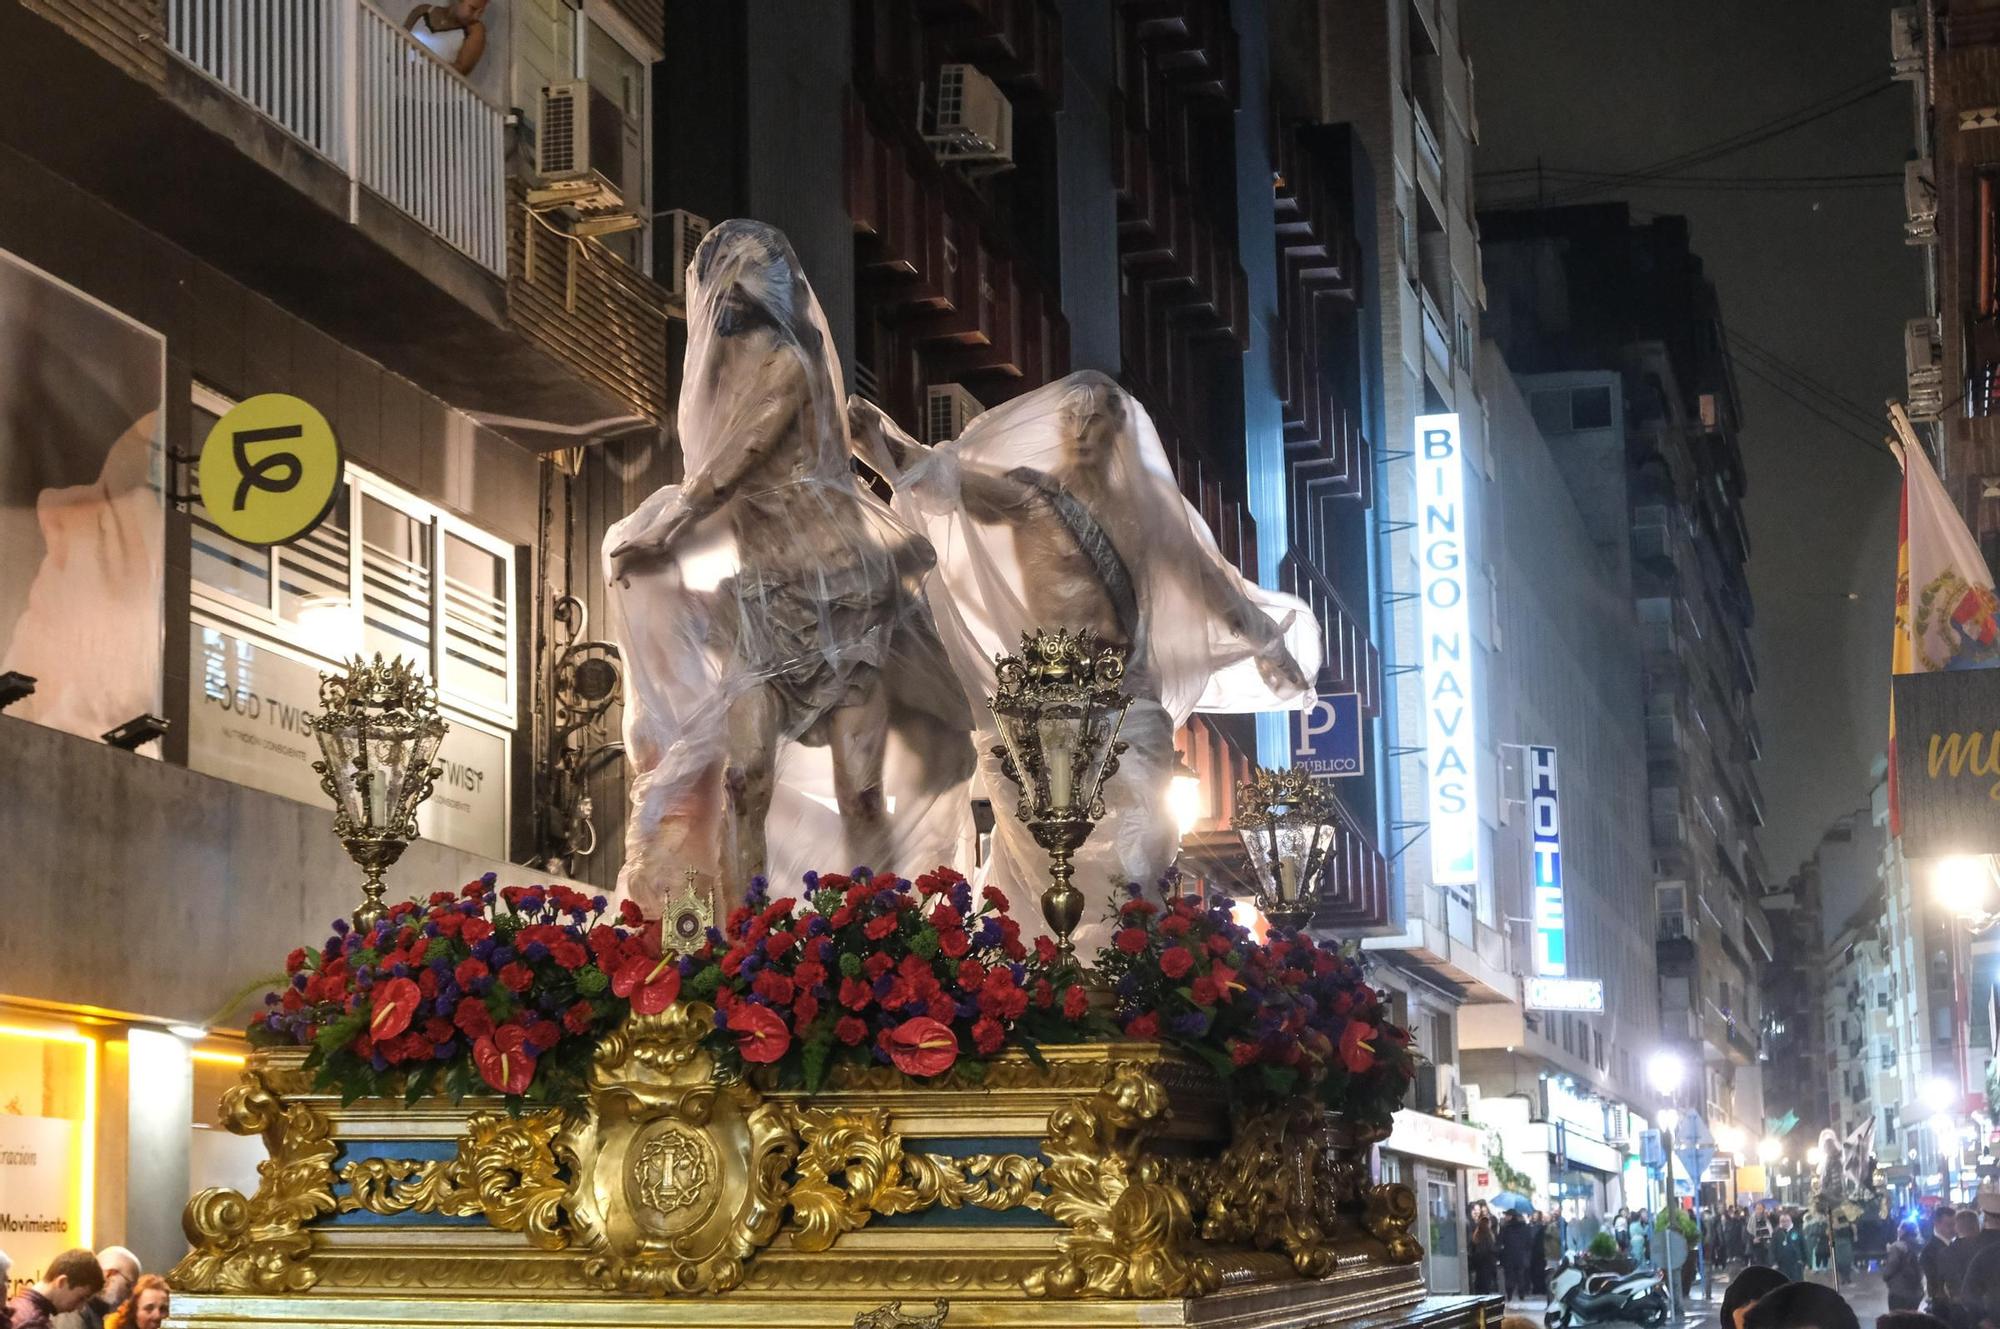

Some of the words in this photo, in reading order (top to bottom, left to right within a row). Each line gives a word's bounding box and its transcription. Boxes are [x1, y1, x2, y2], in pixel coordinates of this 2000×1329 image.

[1423, 429, 1461, 609] BINGO
[1295, 700, 1336, 756] P
[1432, 631, 1467, 814] NAVAS
[1531, 750, 1566, 977] HOTEL
